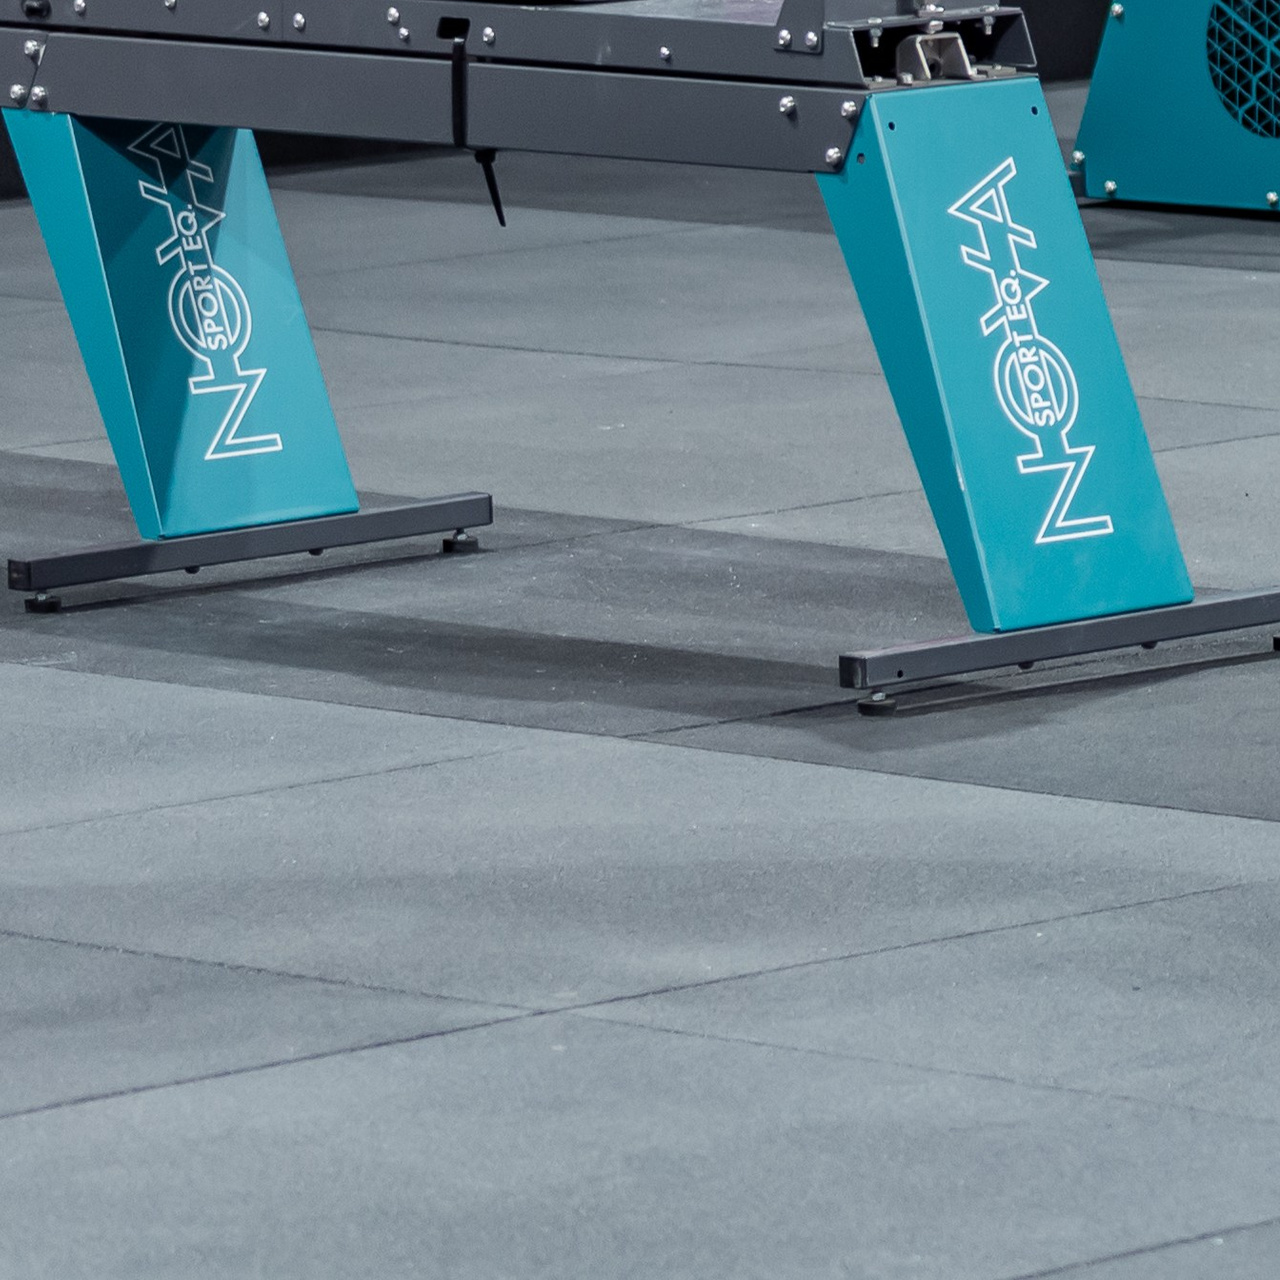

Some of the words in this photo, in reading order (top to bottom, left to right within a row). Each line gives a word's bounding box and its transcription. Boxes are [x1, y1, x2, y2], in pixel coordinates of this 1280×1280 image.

[187, 261, 229, 351] SPORT
[1000, 268, 1030, 320] EQ.
[1012, 331, 1056, 428] SPORT
